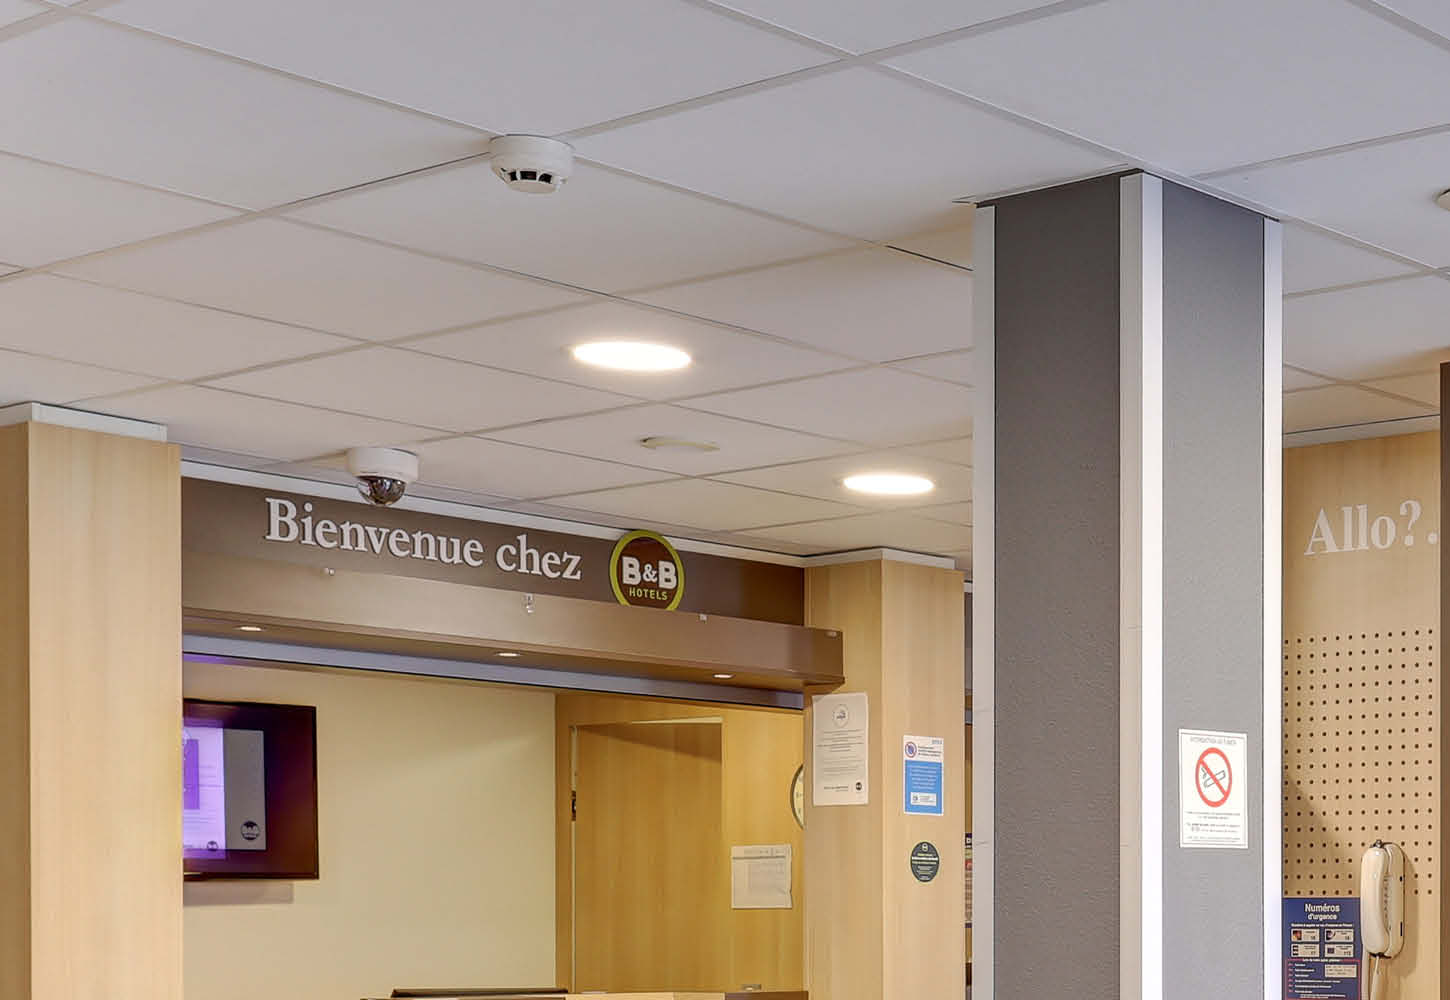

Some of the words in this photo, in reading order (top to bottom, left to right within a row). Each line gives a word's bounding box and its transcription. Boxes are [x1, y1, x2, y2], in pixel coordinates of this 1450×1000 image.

[264, 497, 484, 569] Bienvenue
[496, 534, 582, 581] chez
[621, 556, 678, 590] B&B
[628, 587, 669, 601] HOTELS
[1305, 903, 1340, 912] Numéros
